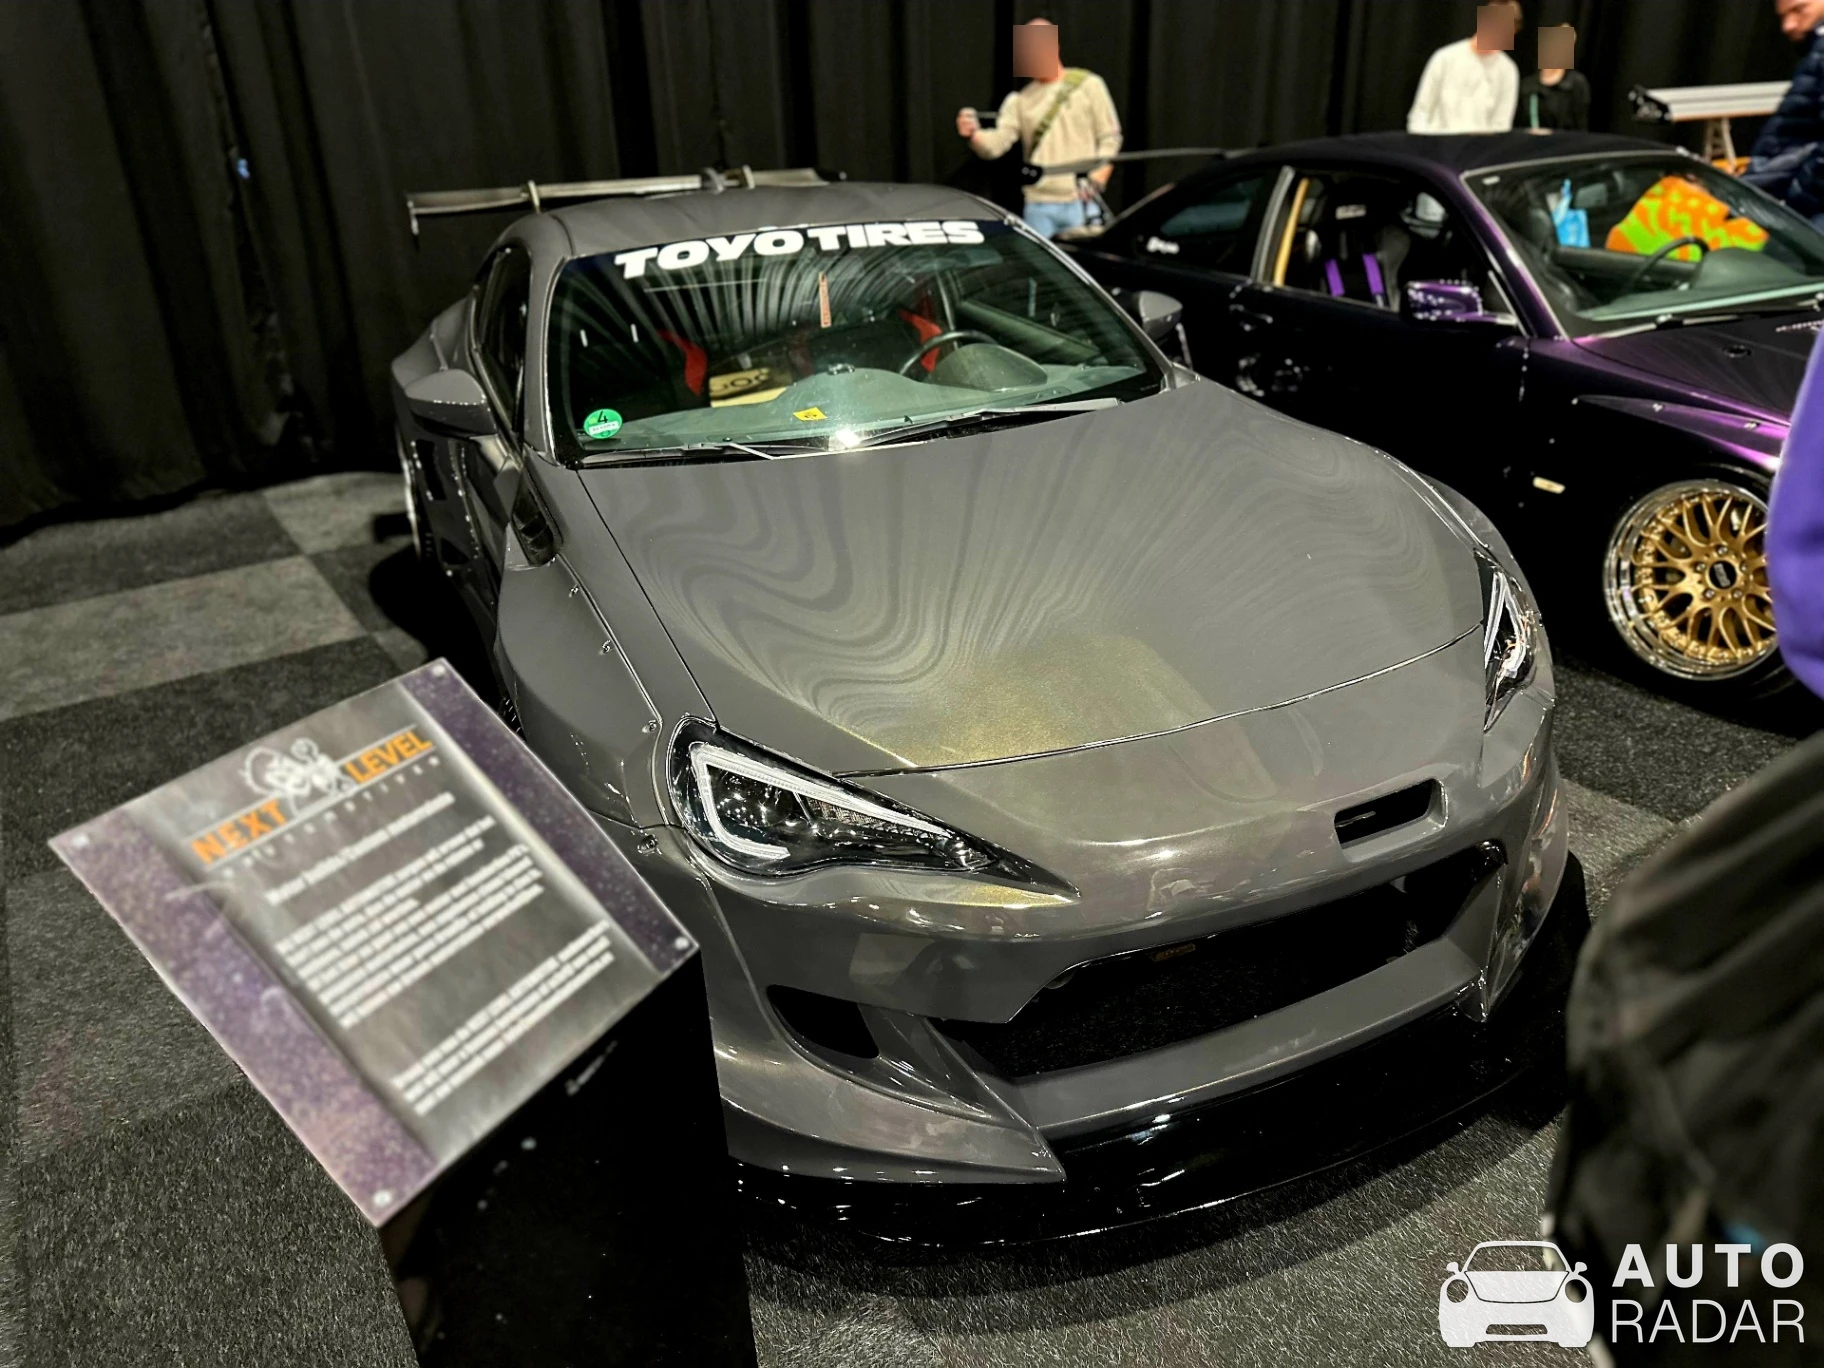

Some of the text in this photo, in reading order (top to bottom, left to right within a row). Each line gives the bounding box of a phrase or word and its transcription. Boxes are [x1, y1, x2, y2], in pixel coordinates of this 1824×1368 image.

[615, 221, 985, 280] TOYO TIRES
[597, 410, 608, 423] 4
[191, 799, 287, 865] NEXT
[344, 731, 432, 784] LEVEL
